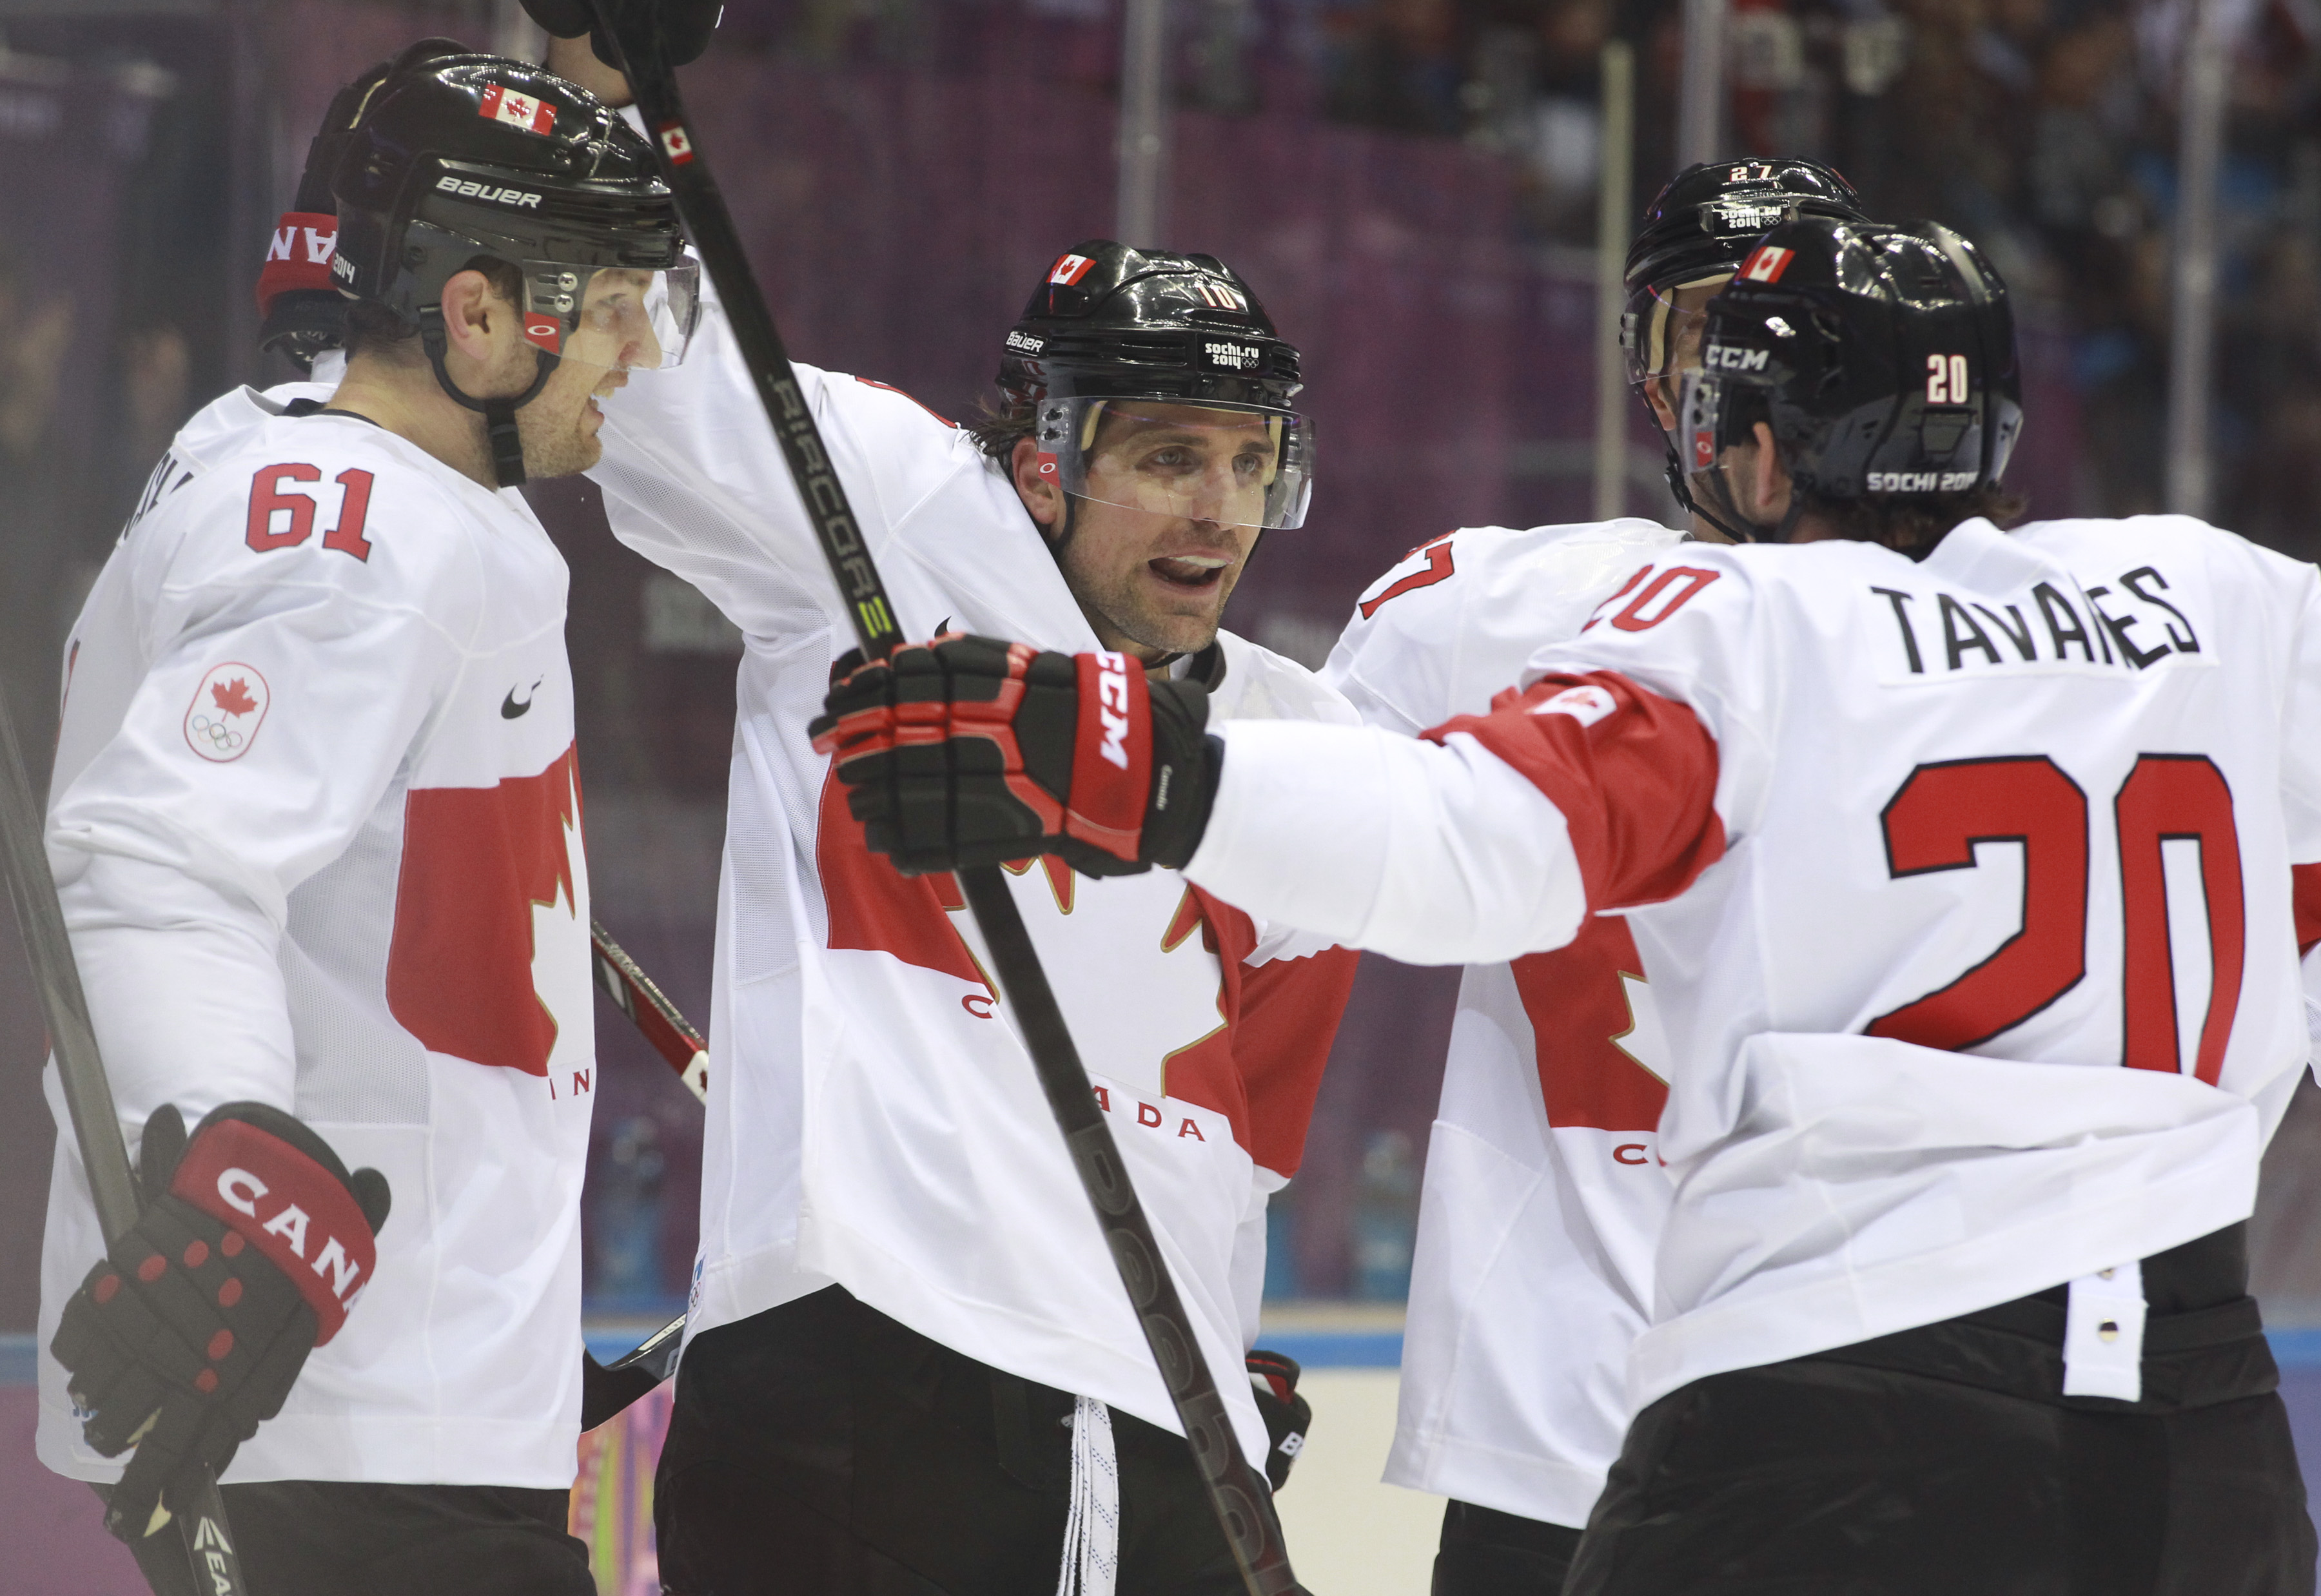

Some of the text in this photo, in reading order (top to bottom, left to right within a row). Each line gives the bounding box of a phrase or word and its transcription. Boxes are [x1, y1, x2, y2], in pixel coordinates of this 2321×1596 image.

[1730, 165, 1773, 182] 27
[436, 176, 542, 208] BAUER
[1729, 217, 1761, 229] 2014
[1194, 281, 1239, 310] 10
[1006, 334, 1044, 353] BAUER
[1205, 342, 1259, 358] sochi.ru
[1212, 354, 1242, 369] 2014
[1706, 344, 1770, 371] CCM
[1926, 354, 1968, 404] 20
[1867, 472, 1937, 492] SOCHI
[245, 463, 375, 563] 61
[1097, 650, 1128, 770] CCM
[1860, 752, 2246, 1088] 20
